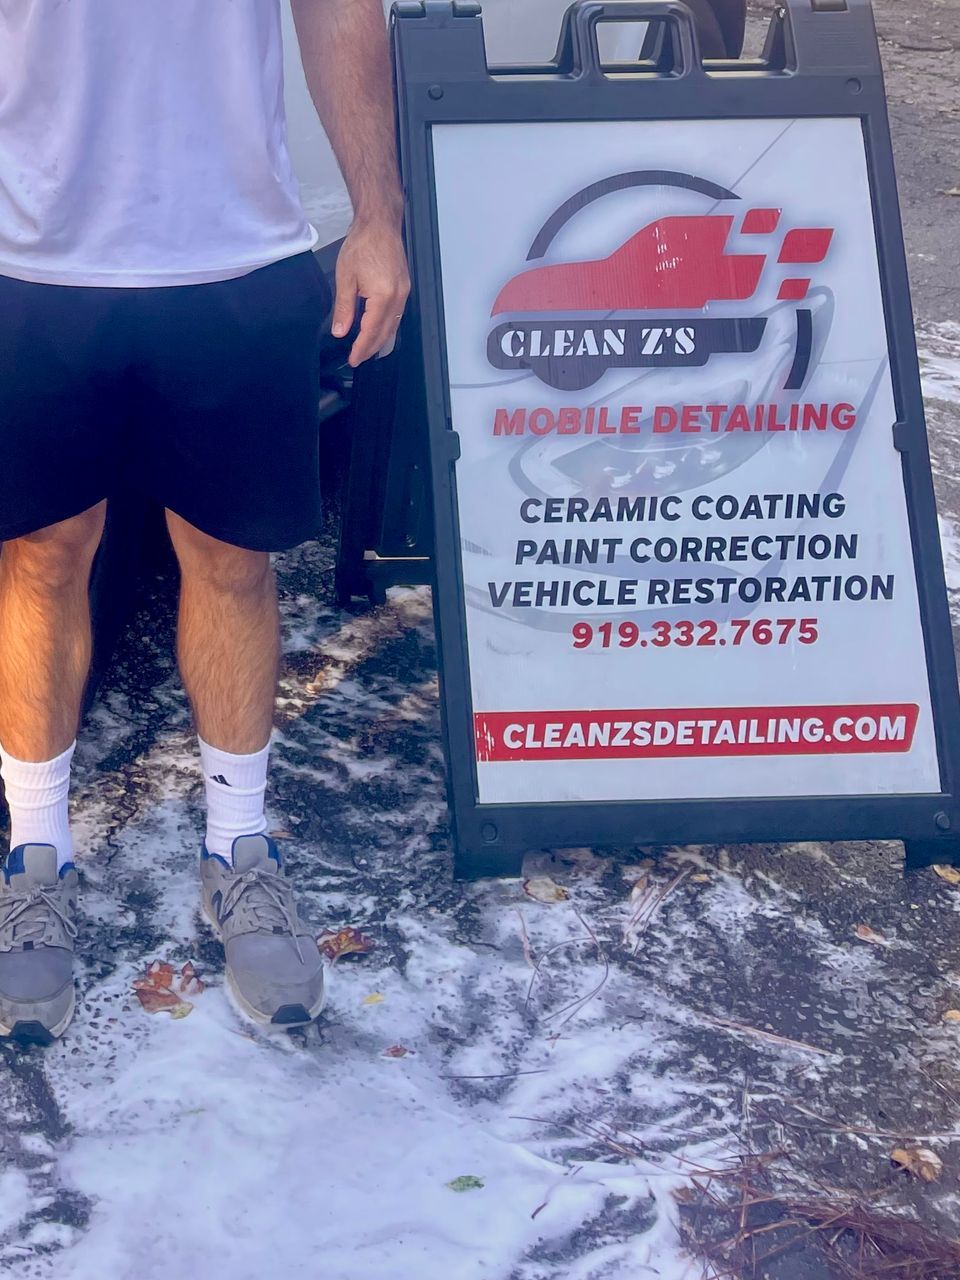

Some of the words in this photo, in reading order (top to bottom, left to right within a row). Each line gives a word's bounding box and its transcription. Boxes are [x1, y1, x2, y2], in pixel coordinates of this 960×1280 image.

[500, 327, 626, 358] CLEAN
[640, 325, 697, 356] Z'S
[492, 406, 643, 437] MOBILE
[652, 402, 858, 434] DETAILING
[519, 495, 683, 524] CERAMIC
[690, 492, 847, 521] COATING
[514, 537, 623, 566] PAINT
[628, 533, 859, 564] CORRECTION
[487, 579, 638, 608] VEHICLE
[646, 574, 895, 605] RESTORATION
[571, 618, 819, 649] 919.332.7675
[502, 715, 907, 750] CLEANZSDETAILING.COM
